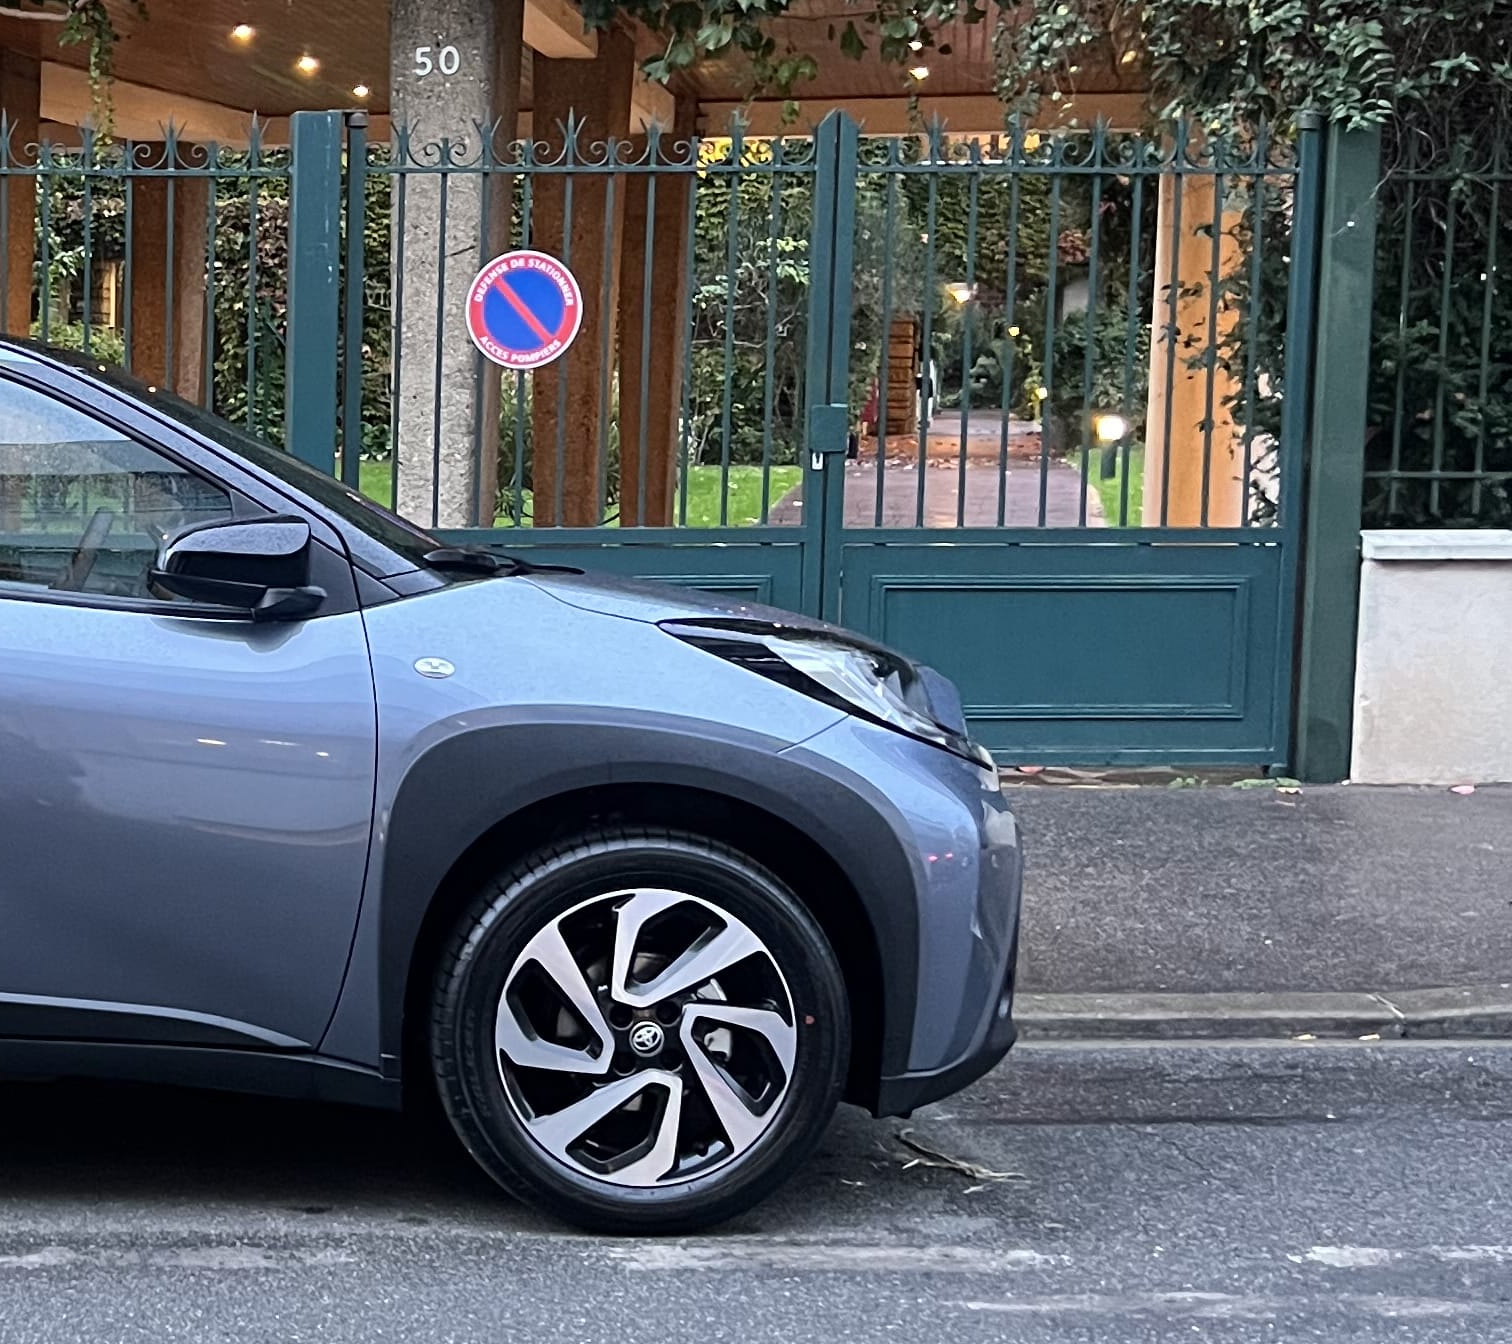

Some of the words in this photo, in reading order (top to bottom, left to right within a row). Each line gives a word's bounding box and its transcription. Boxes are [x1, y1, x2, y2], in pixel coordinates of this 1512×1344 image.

[416, 45, 460, 76] 50
[474, 262, 509, 302] DEFENSE
[509, 258, 525, 268] DE
[528, 258, 574, 306] STATIONNER
[479, 336, 509, 360] ACCES
[510, 339, 561, 363] POMPIERS
